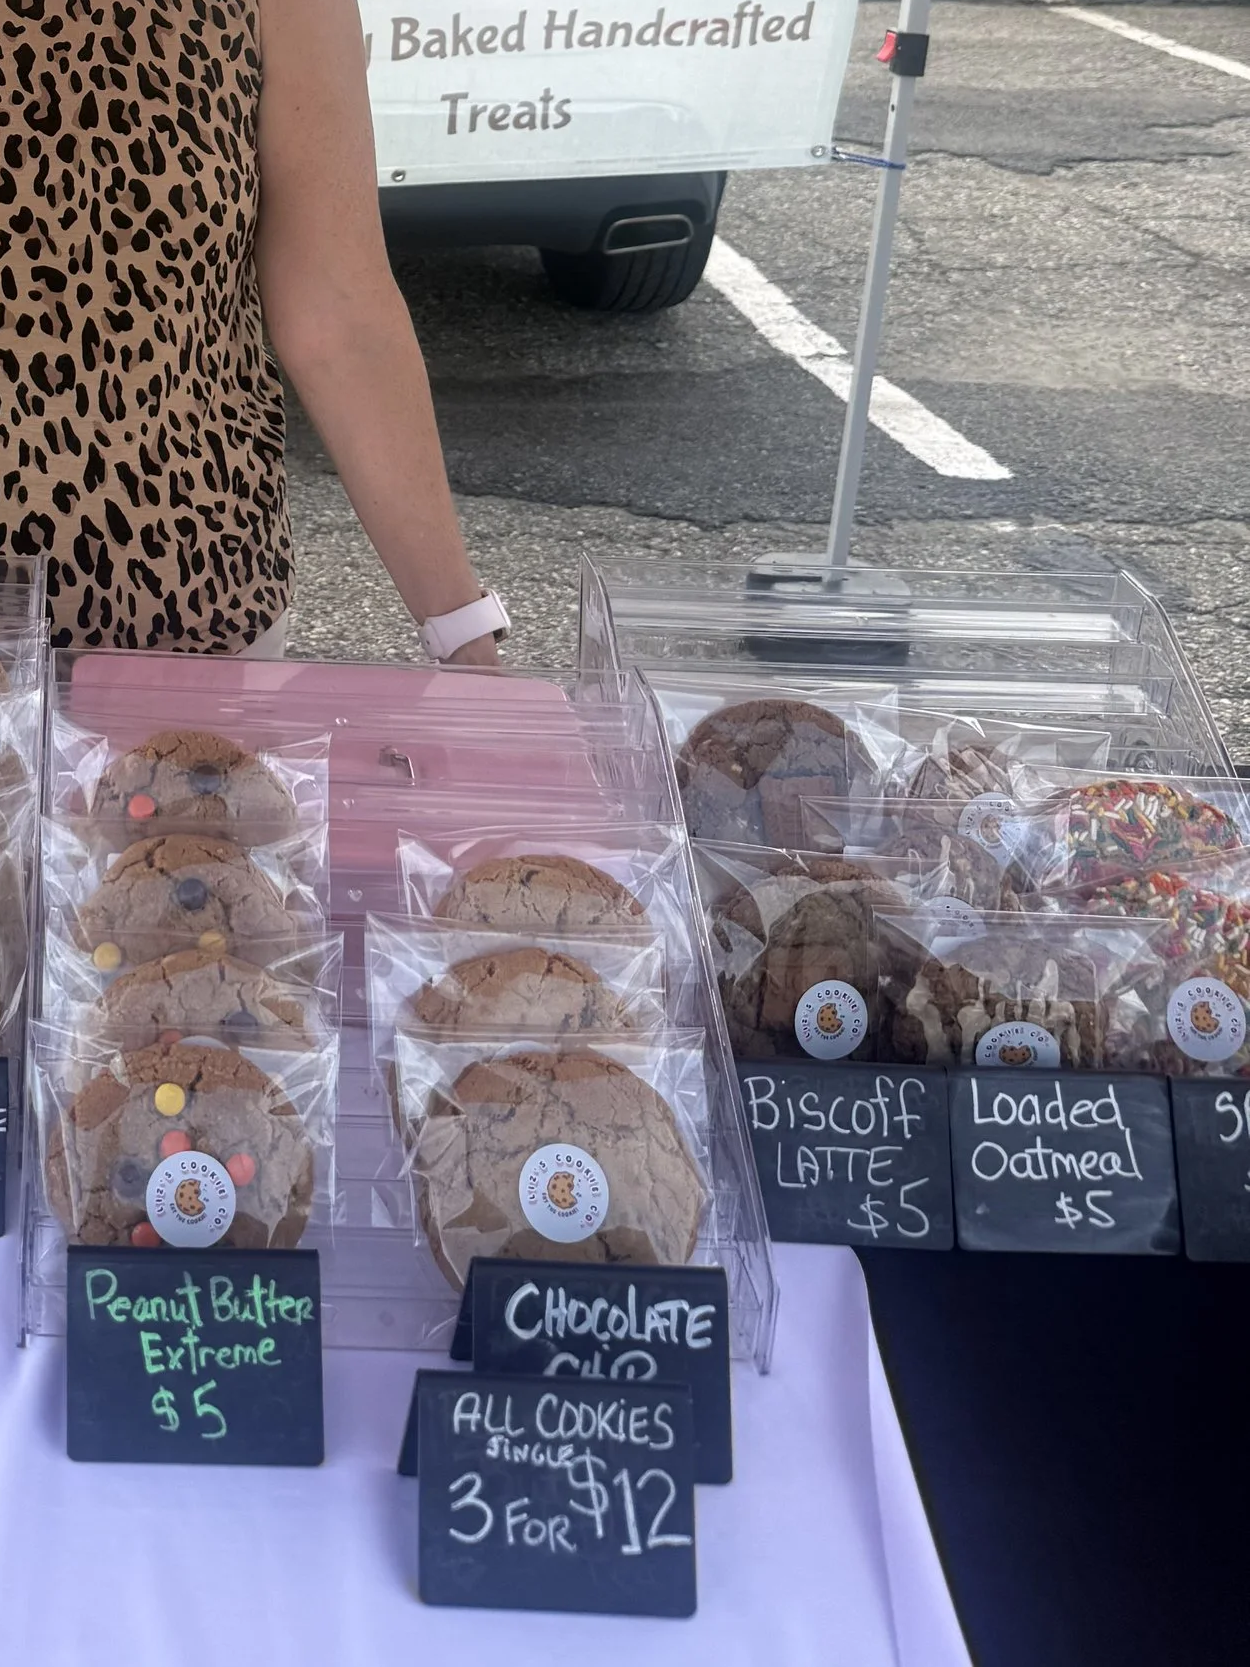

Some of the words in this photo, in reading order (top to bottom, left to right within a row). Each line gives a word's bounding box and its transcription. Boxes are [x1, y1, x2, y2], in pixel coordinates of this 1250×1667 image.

[390, 9, 528, 61] Baked
[544, 0, 816, 51] Handcrafted
[440, 86, 574, 135] Treats
[743, 1074, 926, 1139] Biscoff
[970, 1077, 1125, 1131] Loaded
[777, 1141, 903, 1188] LATTE
[971, 1127, 1143, 1181] Oatmeal
[846, 1177, 930, 1239] $5
[1054, 1190, 1116, 1230] $5
[85, 1268, 204, 1328] Peanut
[504, 1282, 716, 1349] CHOCOLATE
[140, 1328, 282, 1375] Extreme
[151, 1379, 227, 1439] $5
[453, 1392, 525, 1434] ALL
[448, 1471, 494, 1544] 3
[505, 1497, 578, 1553] FOR
[567, 1446, 693, 1555] $12
